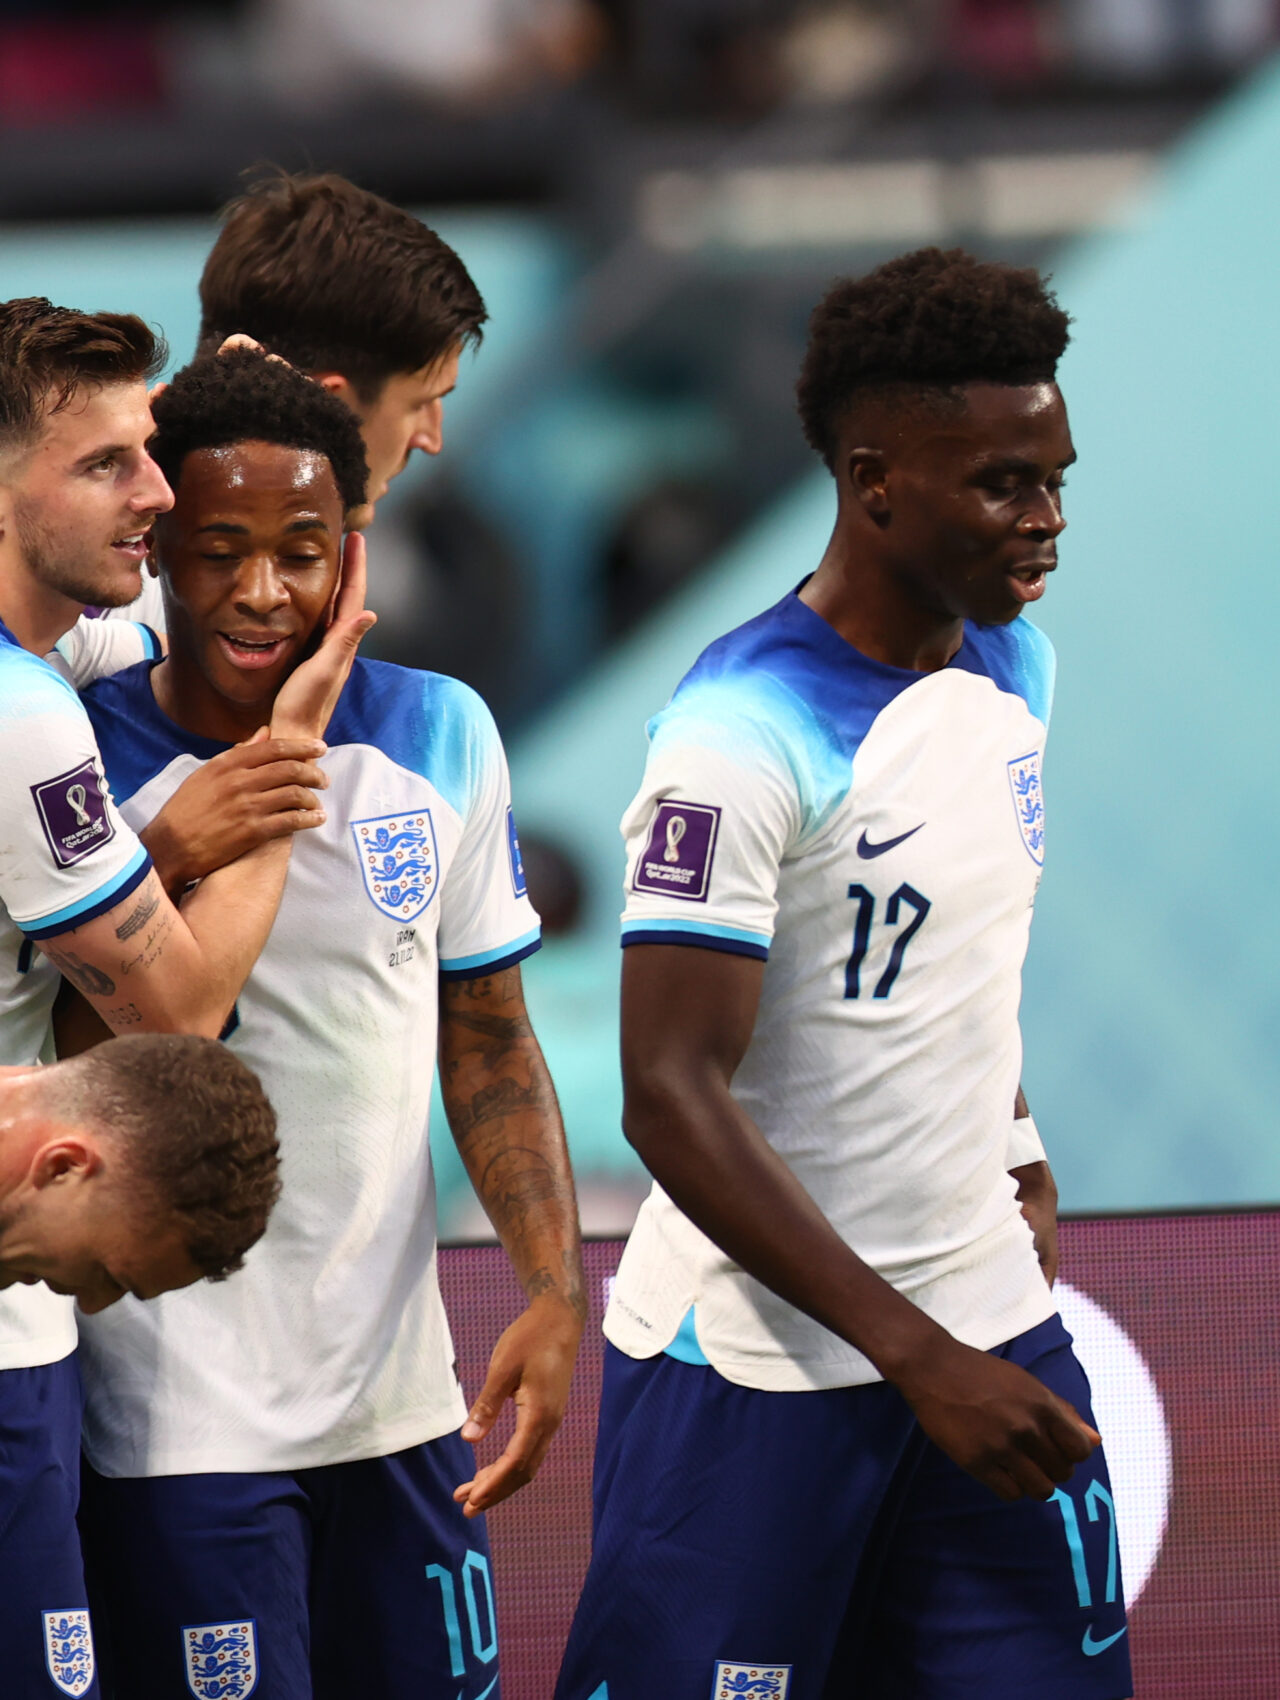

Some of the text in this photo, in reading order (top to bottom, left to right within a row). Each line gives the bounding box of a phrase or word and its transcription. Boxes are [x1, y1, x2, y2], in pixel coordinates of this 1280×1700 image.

[843, 881, 932, 1000] 17
[1046, 1478, 1117, 1608] 17
[425, 1549, 498, 1678] 10
